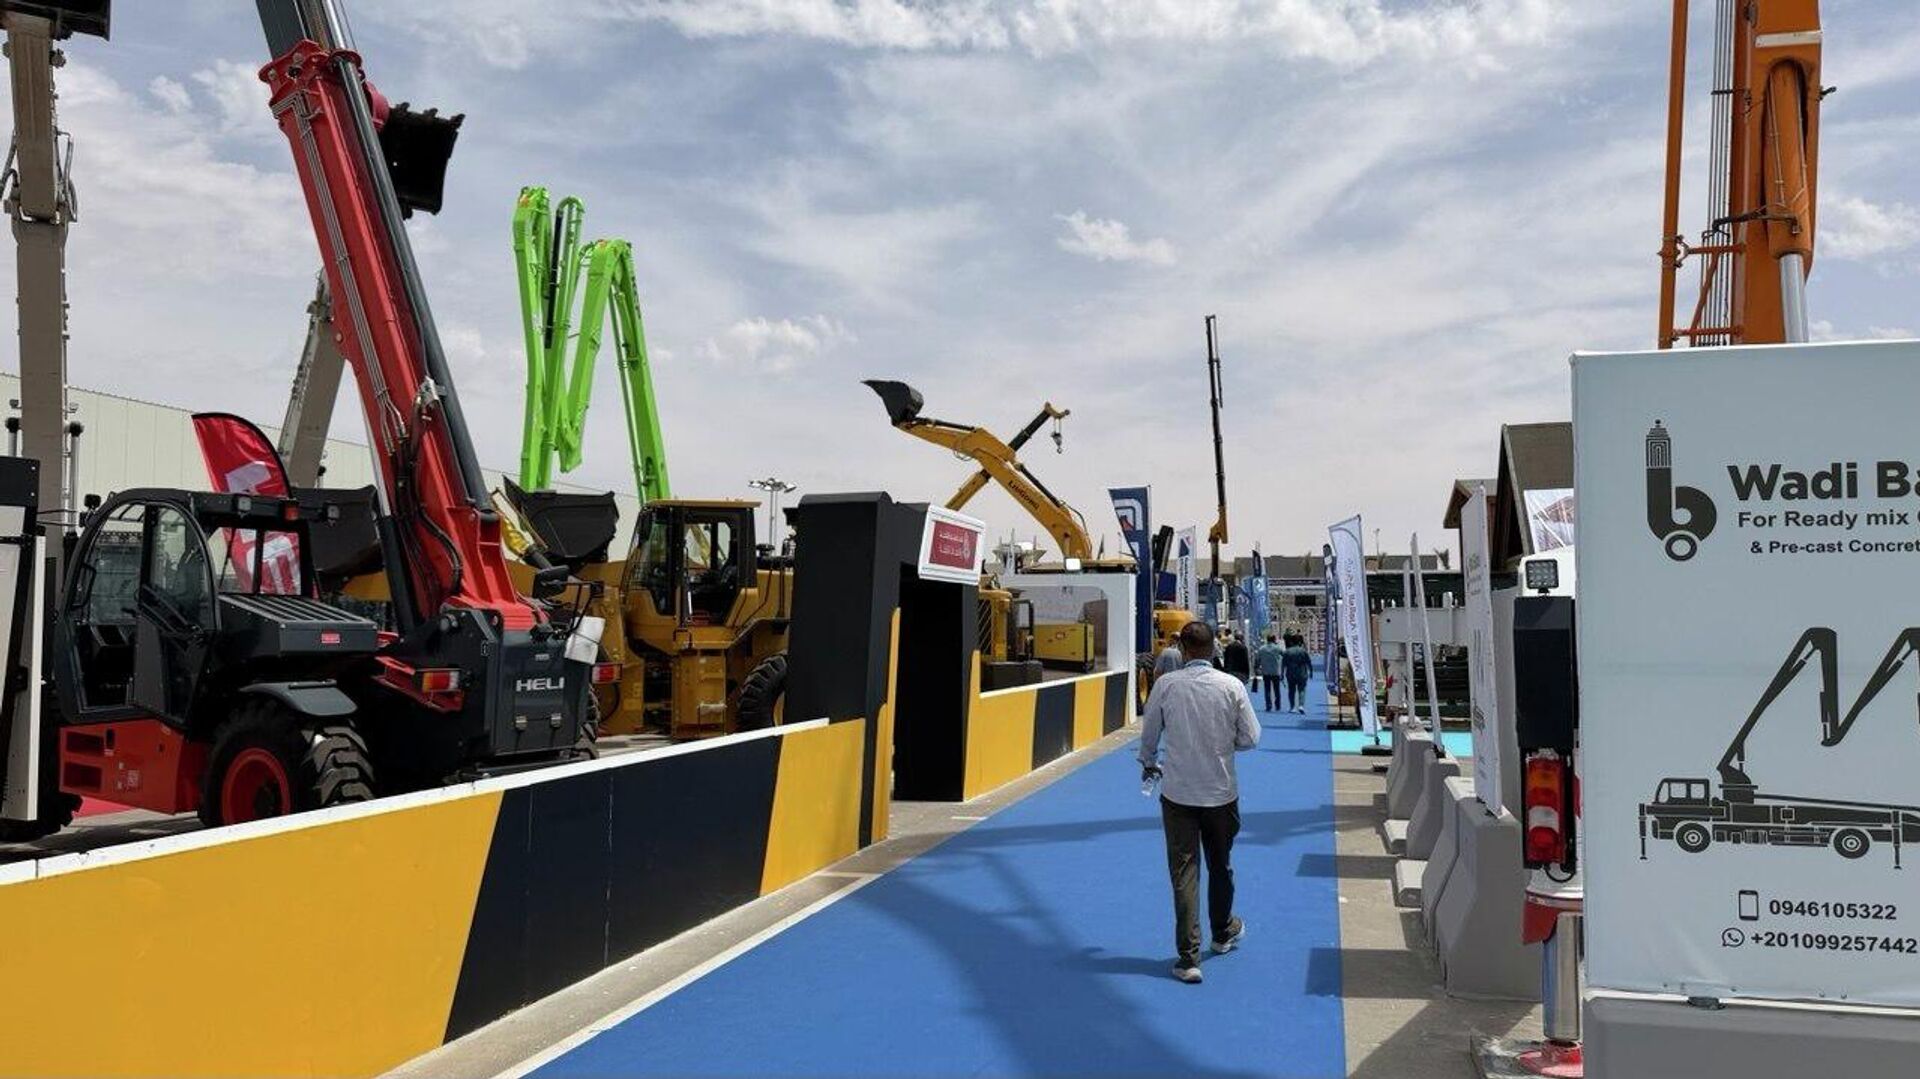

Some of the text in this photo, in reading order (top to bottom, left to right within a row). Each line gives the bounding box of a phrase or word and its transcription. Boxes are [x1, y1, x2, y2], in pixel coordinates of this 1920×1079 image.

[1726, 460, 1920, 501] Wadi B
[1737, 510, 1777, 528] For
[1784, 509, 1858, 531] Ready
[1865, 508, 1909, 526] mix
[1749, 539, 1763, 554] &
[1768, 539, 1843, 554] Pre-cast
[515, 677, 565, 692] HELI
[1769, 899, 1897, 920] 0946105322
[1750, 931, 1918, 954] +201099257442
